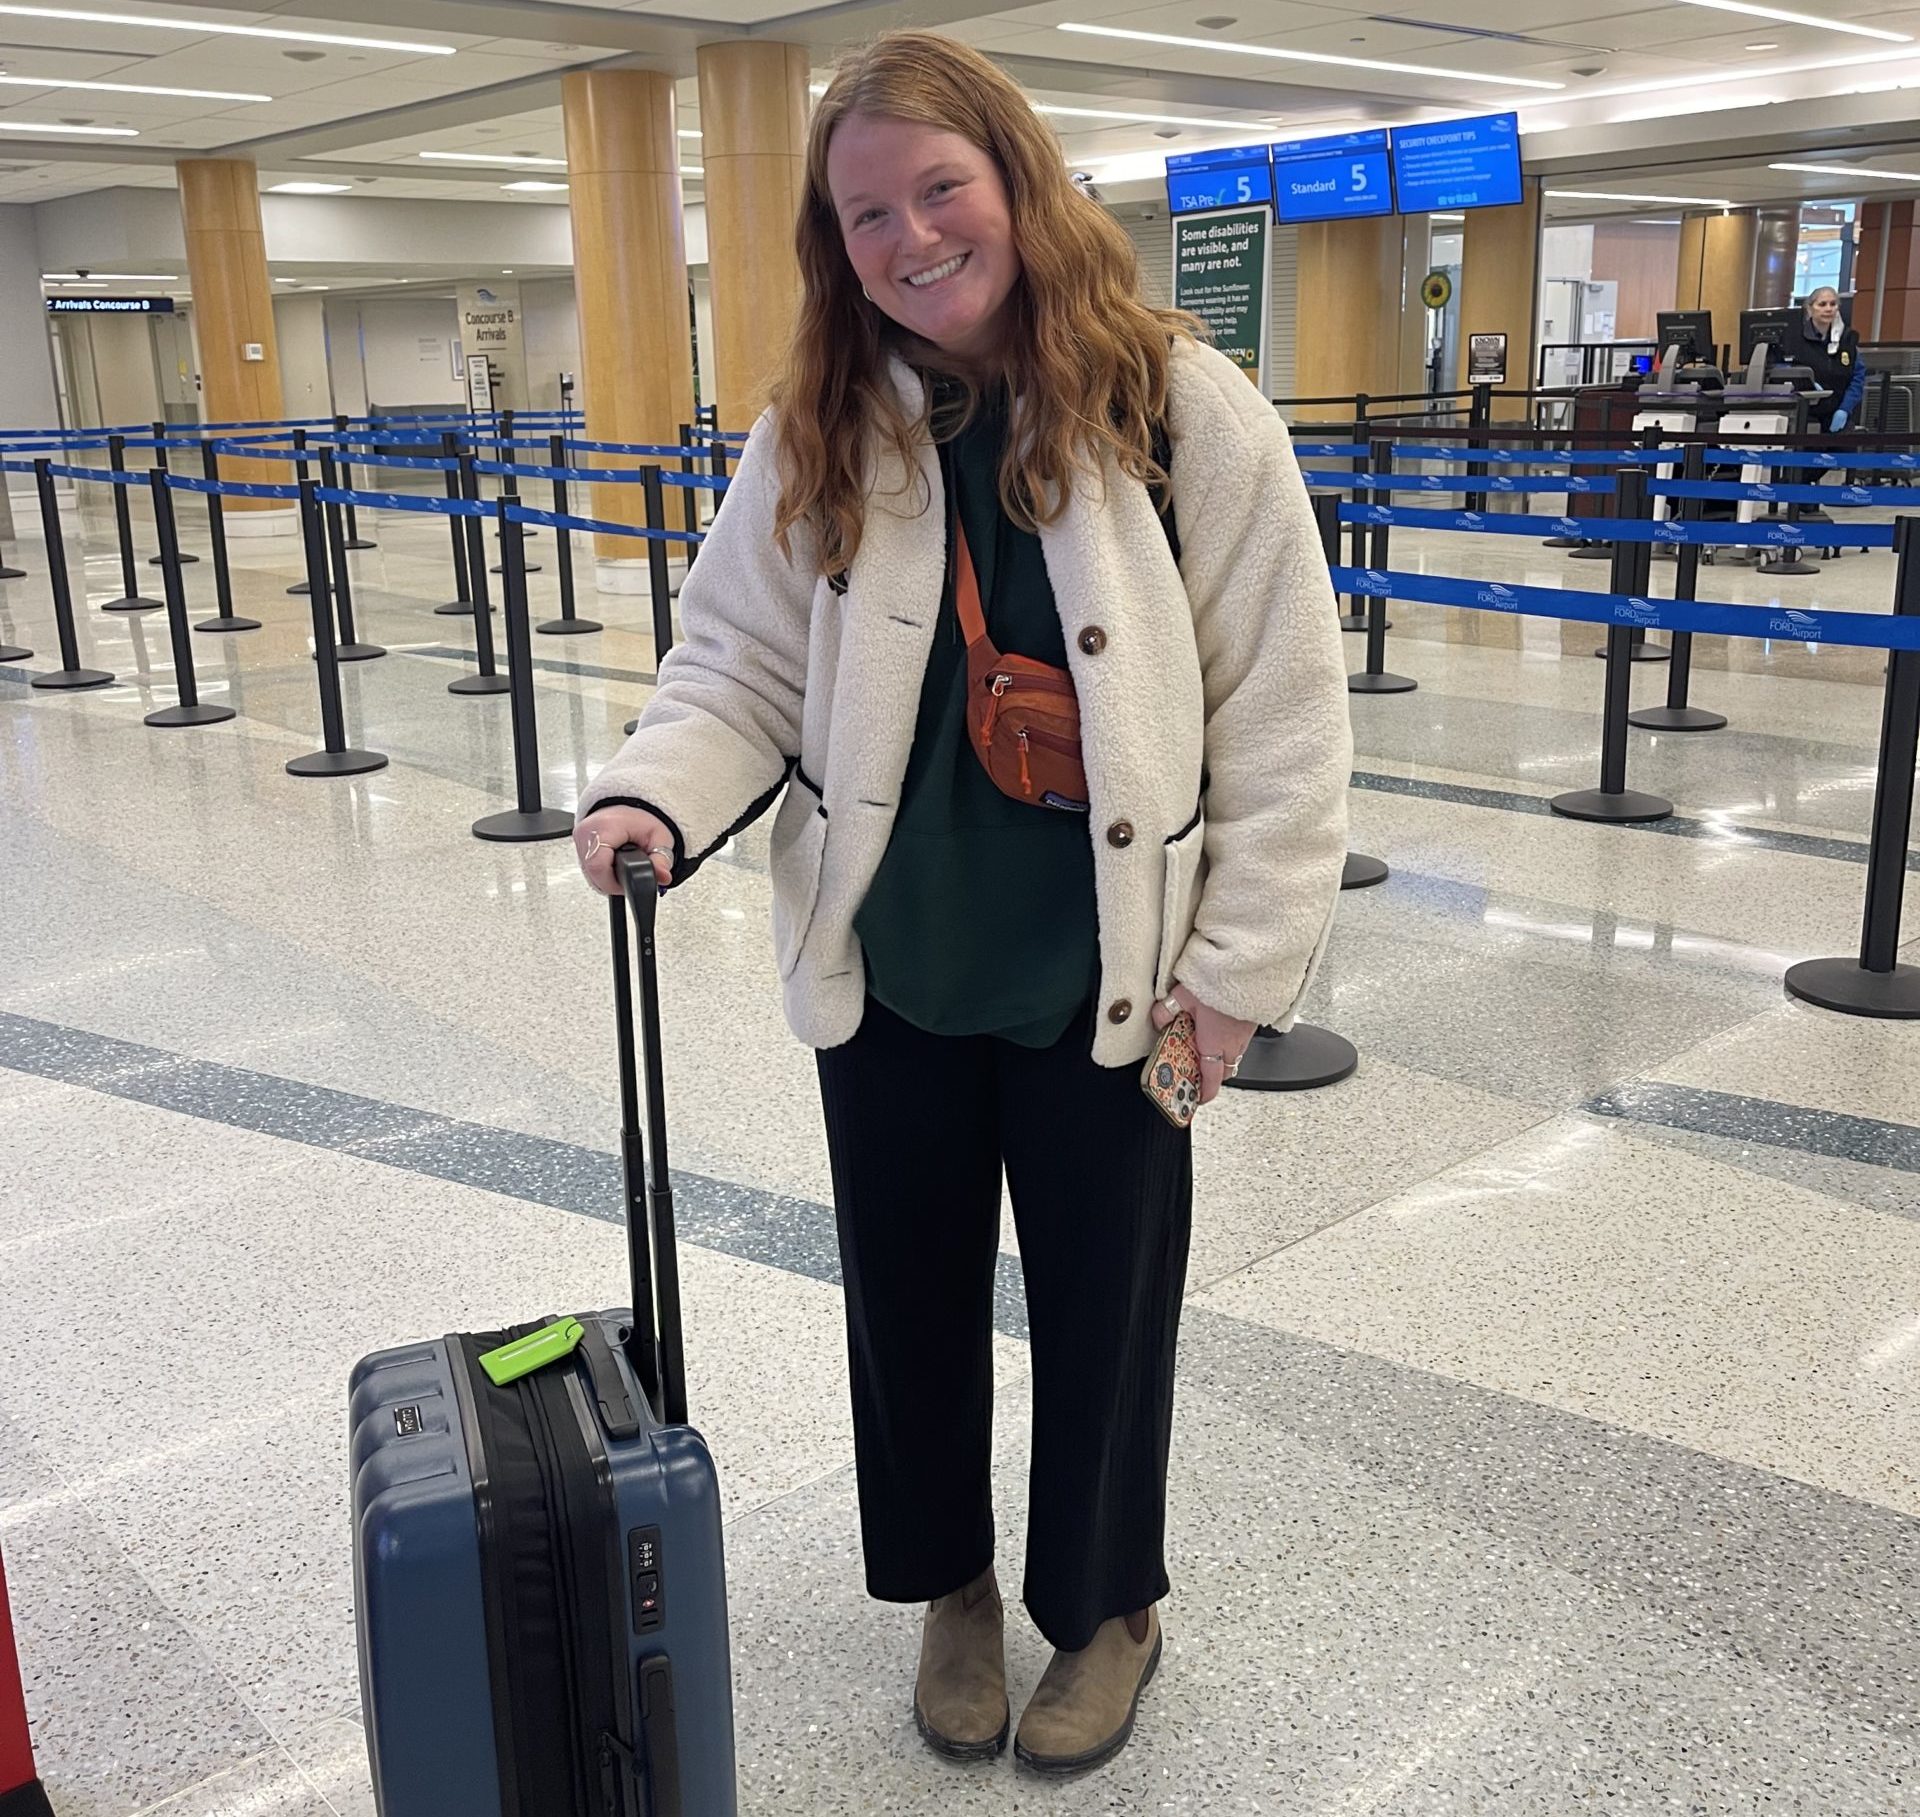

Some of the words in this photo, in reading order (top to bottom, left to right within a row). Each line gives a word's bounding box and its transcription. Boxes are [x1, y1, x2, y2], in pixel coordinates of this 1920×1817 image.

[1290, 178, 1336, 195] Standard
[1351, 163, 1367, 191] 5
[1180, 195, 1199, 208] TSA
[1199, 194, 1214, 206] Pre
[1237, 175, 1252, 203] 5
[1182, 229, 1207, 241] Some
[1208, 222, 1259, 238] disabilities
[1181, 246, 1196, 257] are
[1197, 240, 1230, 254] visible,
[1231, 238, 1249, 251] and
[1181, 260, 1206, 273] many
[1206, 259, 1221, 270] are
[1223, 256, 1242, 268] not.
[1194, 287, 1204, 295] out
[55, 300, 92, 310] Arrivals
[93, 300, 140, 310] Concourse
[142, 300, 150, 310] B
[465, 312, 507, 325] Concourse
[507, 309, 514, 323] B
[476, 327, 507, 341] Arrivals
[1654, 529, 1672, 537] FORD
[1767, 531, 1785, 541] FORD
[1356, 577, 1374, 590] FORD
[1371, 586, 1392, 595] Airport
[1477, 592, 1496, 604] FORD
[1495, 599, 1518, 610] Airport
[1614, 606, 1636, 618] FORD
[1634, 616, 1660, 626] Airport
[1769, 619, 1795, 631] FORD
[1792, 628, 1821, 640] Airport
